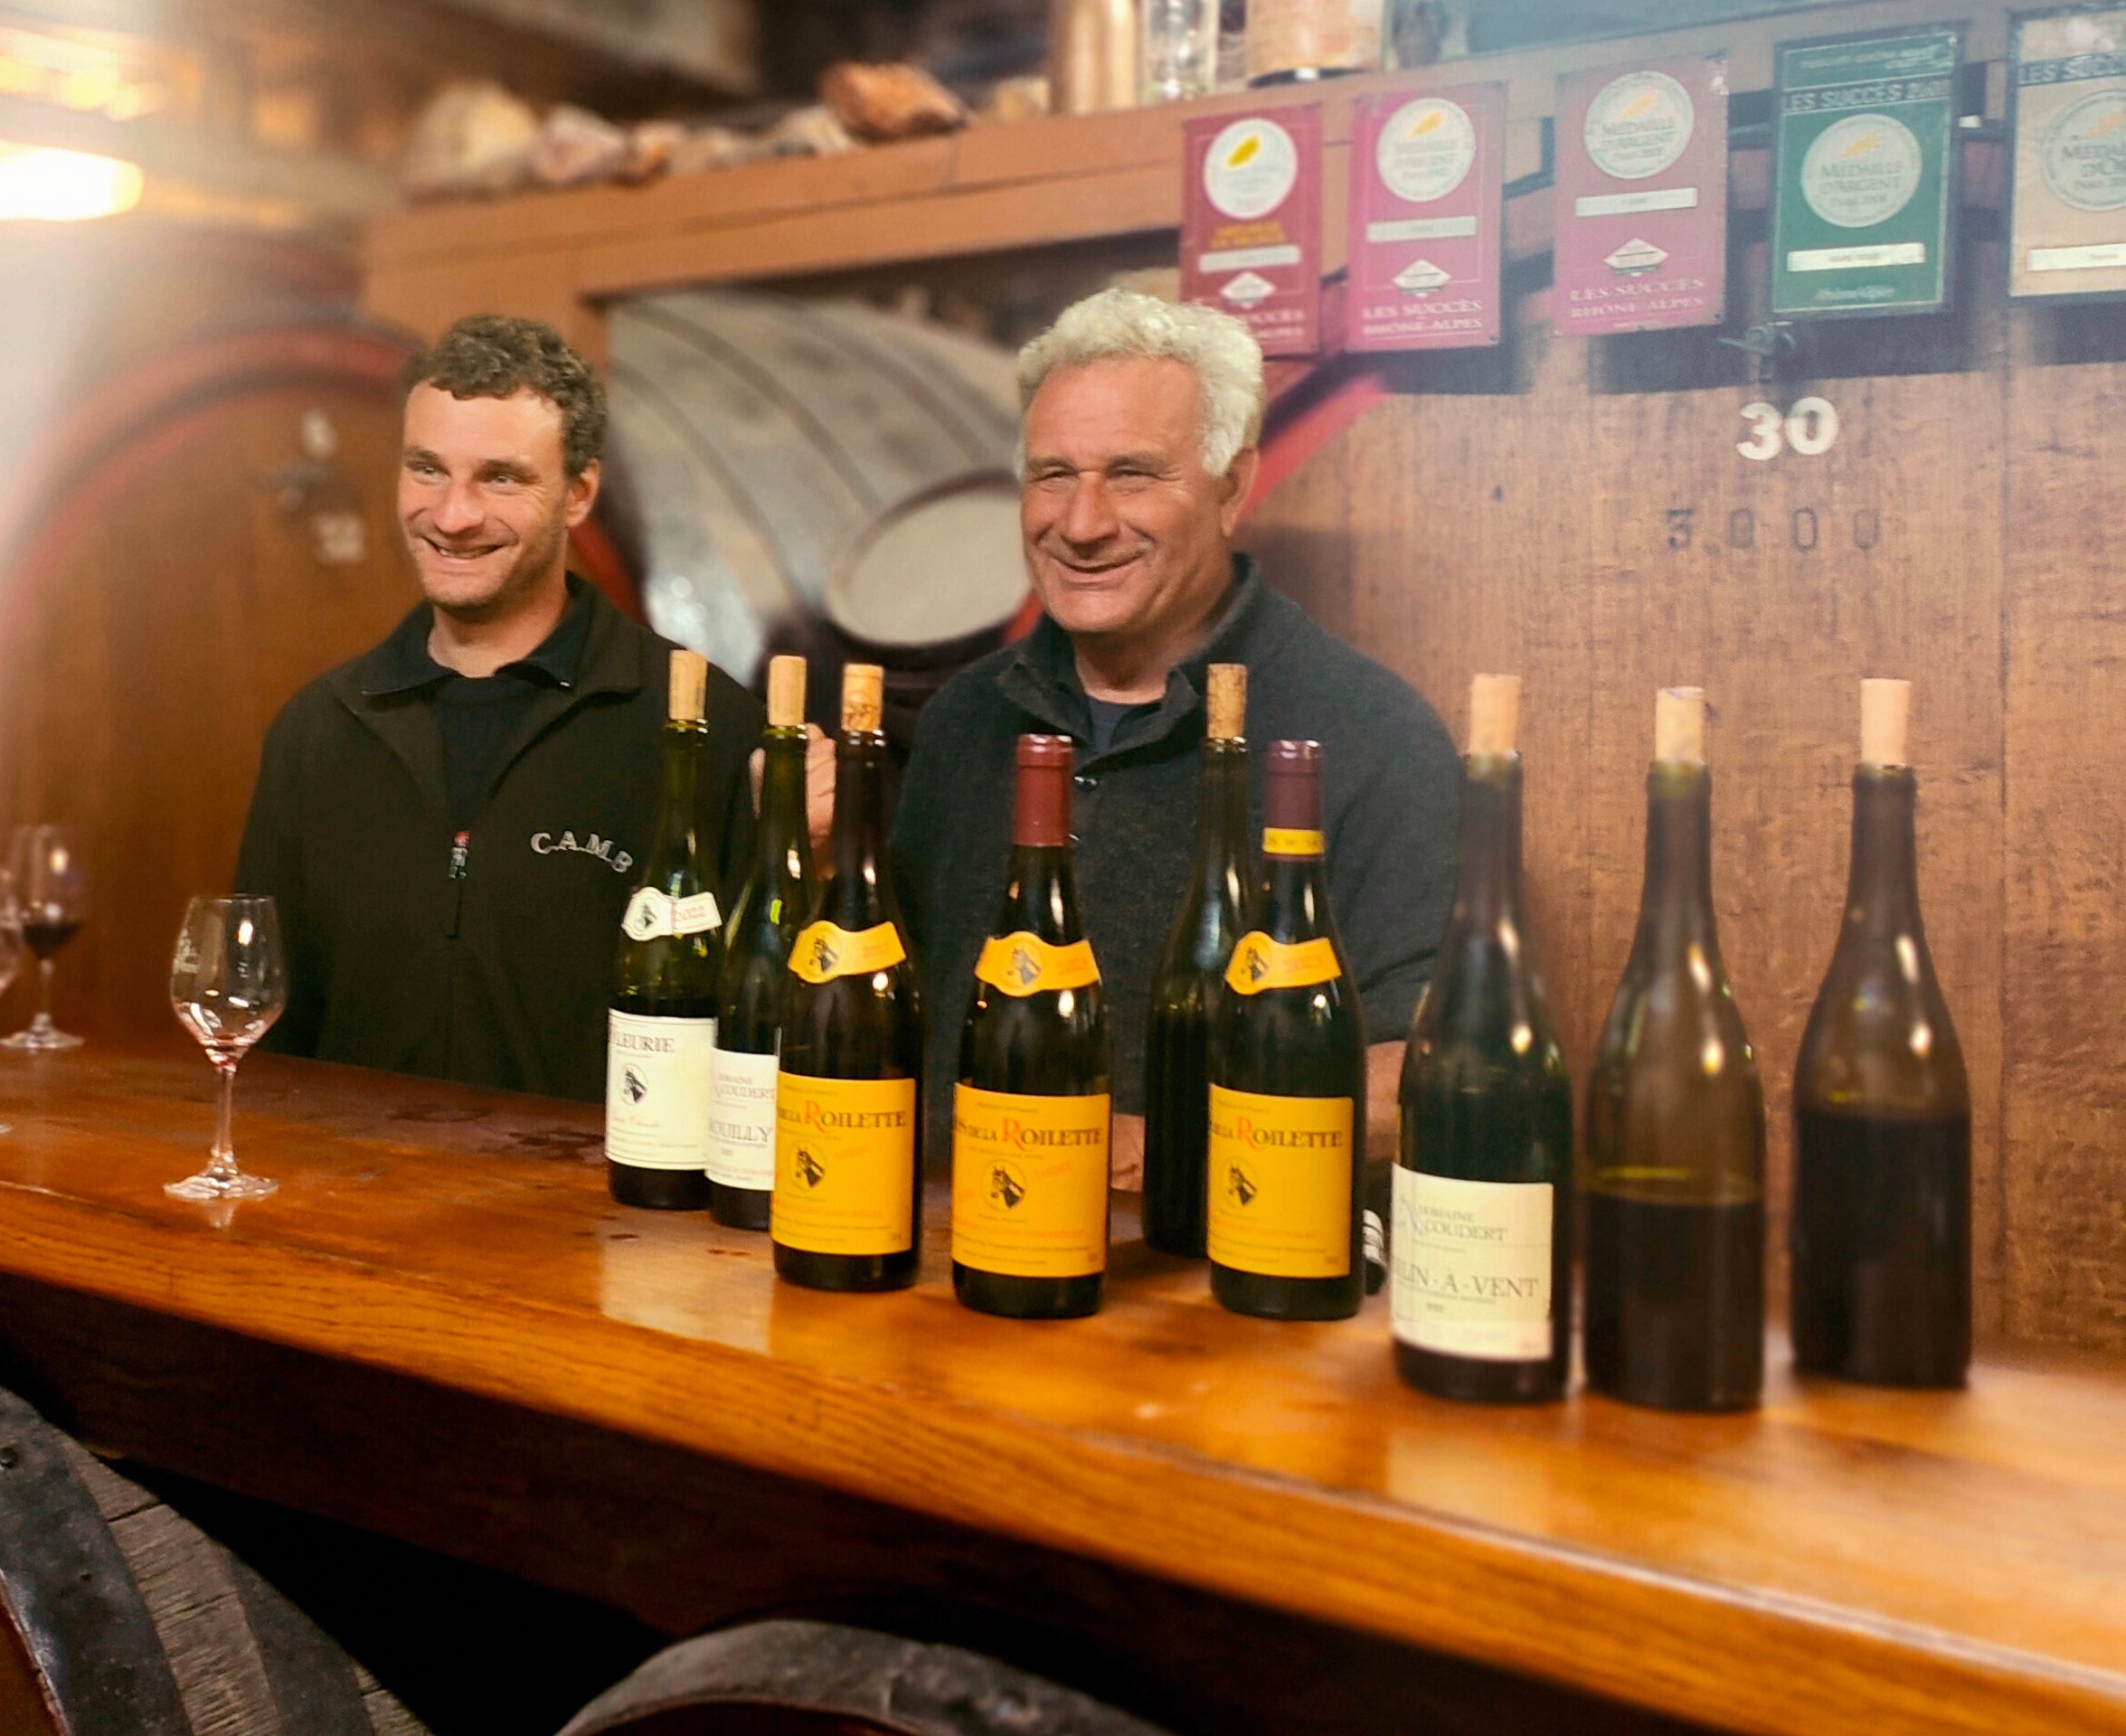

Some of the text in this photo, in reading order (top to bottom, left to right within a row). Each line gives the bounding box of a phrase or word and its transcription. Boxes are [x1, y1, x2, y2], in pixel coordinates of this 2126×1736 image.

[1736, 396, 1839, 460] 30
[804, 1099, 906, 1133] ROILETTE
[1237, 1116, 1344, 1150] ROILETTE
[1003, 1118, 1101, 1151] ROILETTE
